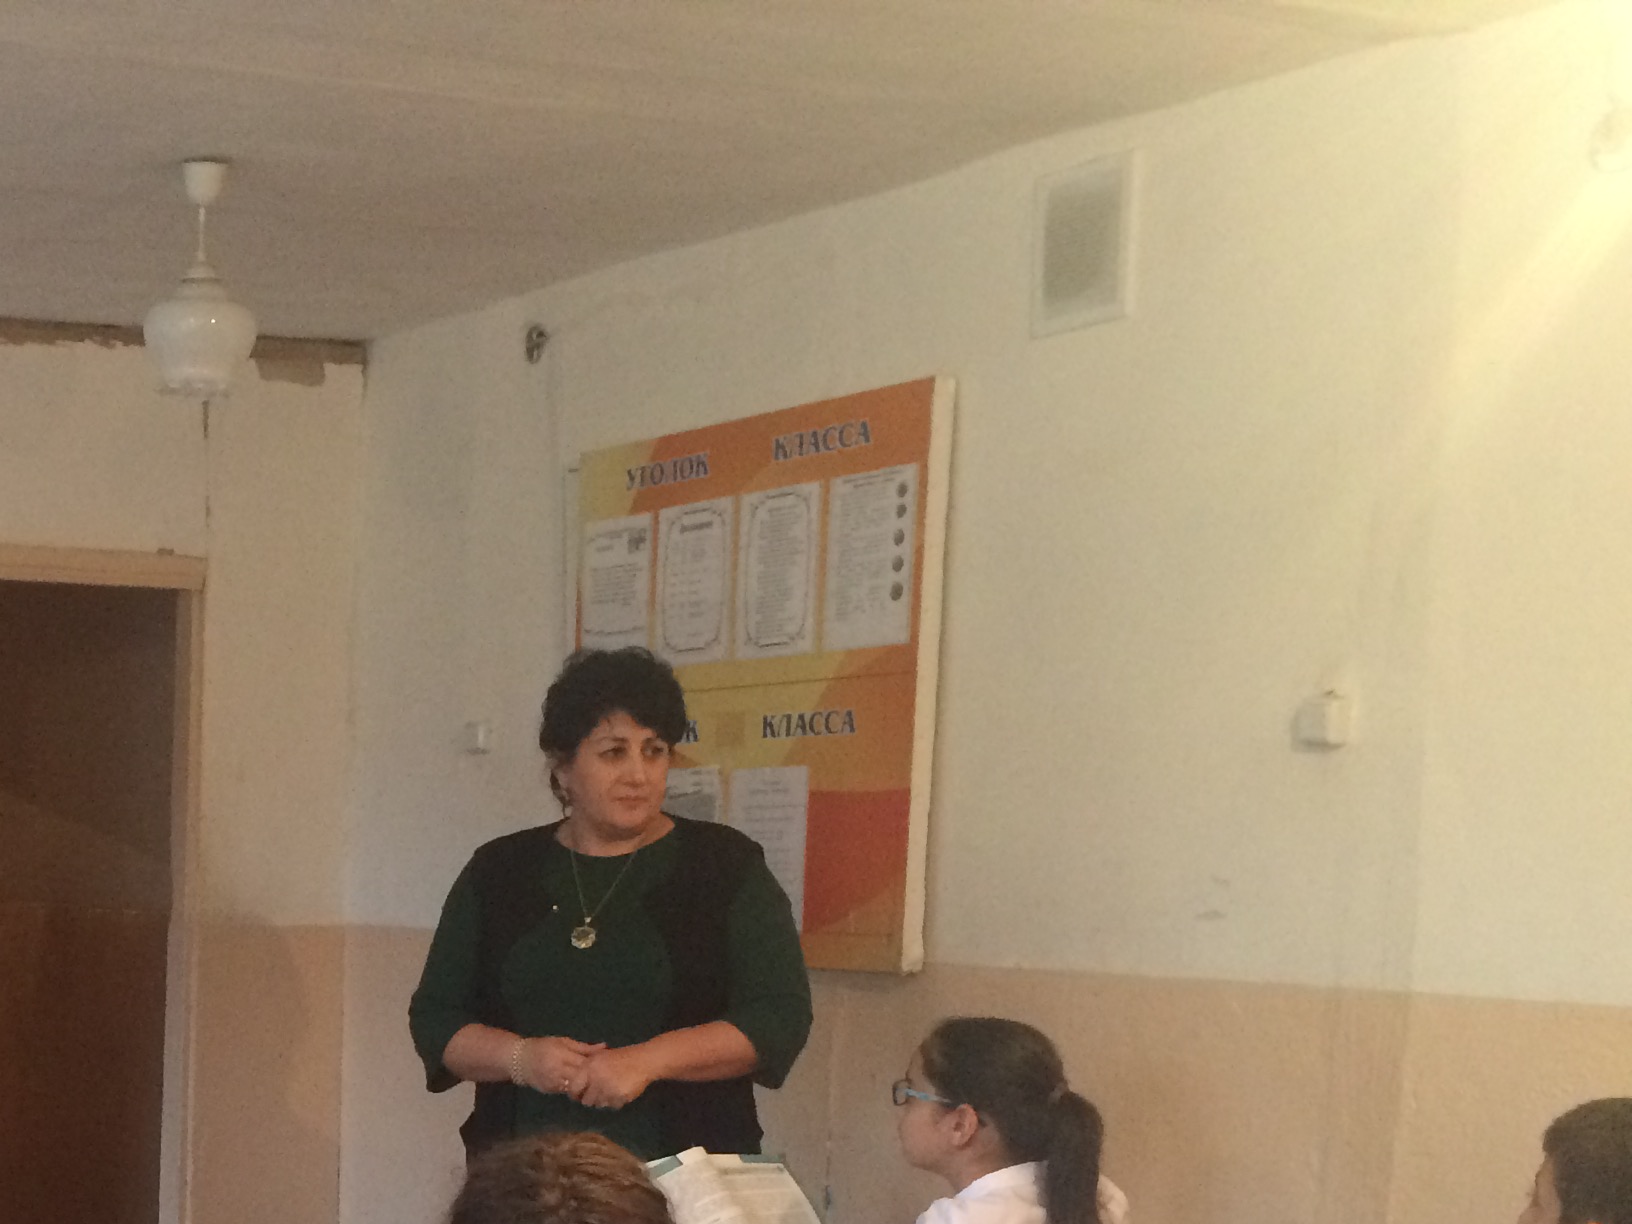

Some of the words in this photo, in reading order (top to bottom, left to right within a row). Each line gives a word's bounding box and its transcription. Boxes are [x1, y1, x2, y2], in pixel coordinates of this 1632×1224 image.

[625, 452, 711, 491] УГОЛОК
[772, 420, 872, 461] КЛАССА
[762, 709, 856, 739] КЛАССА
